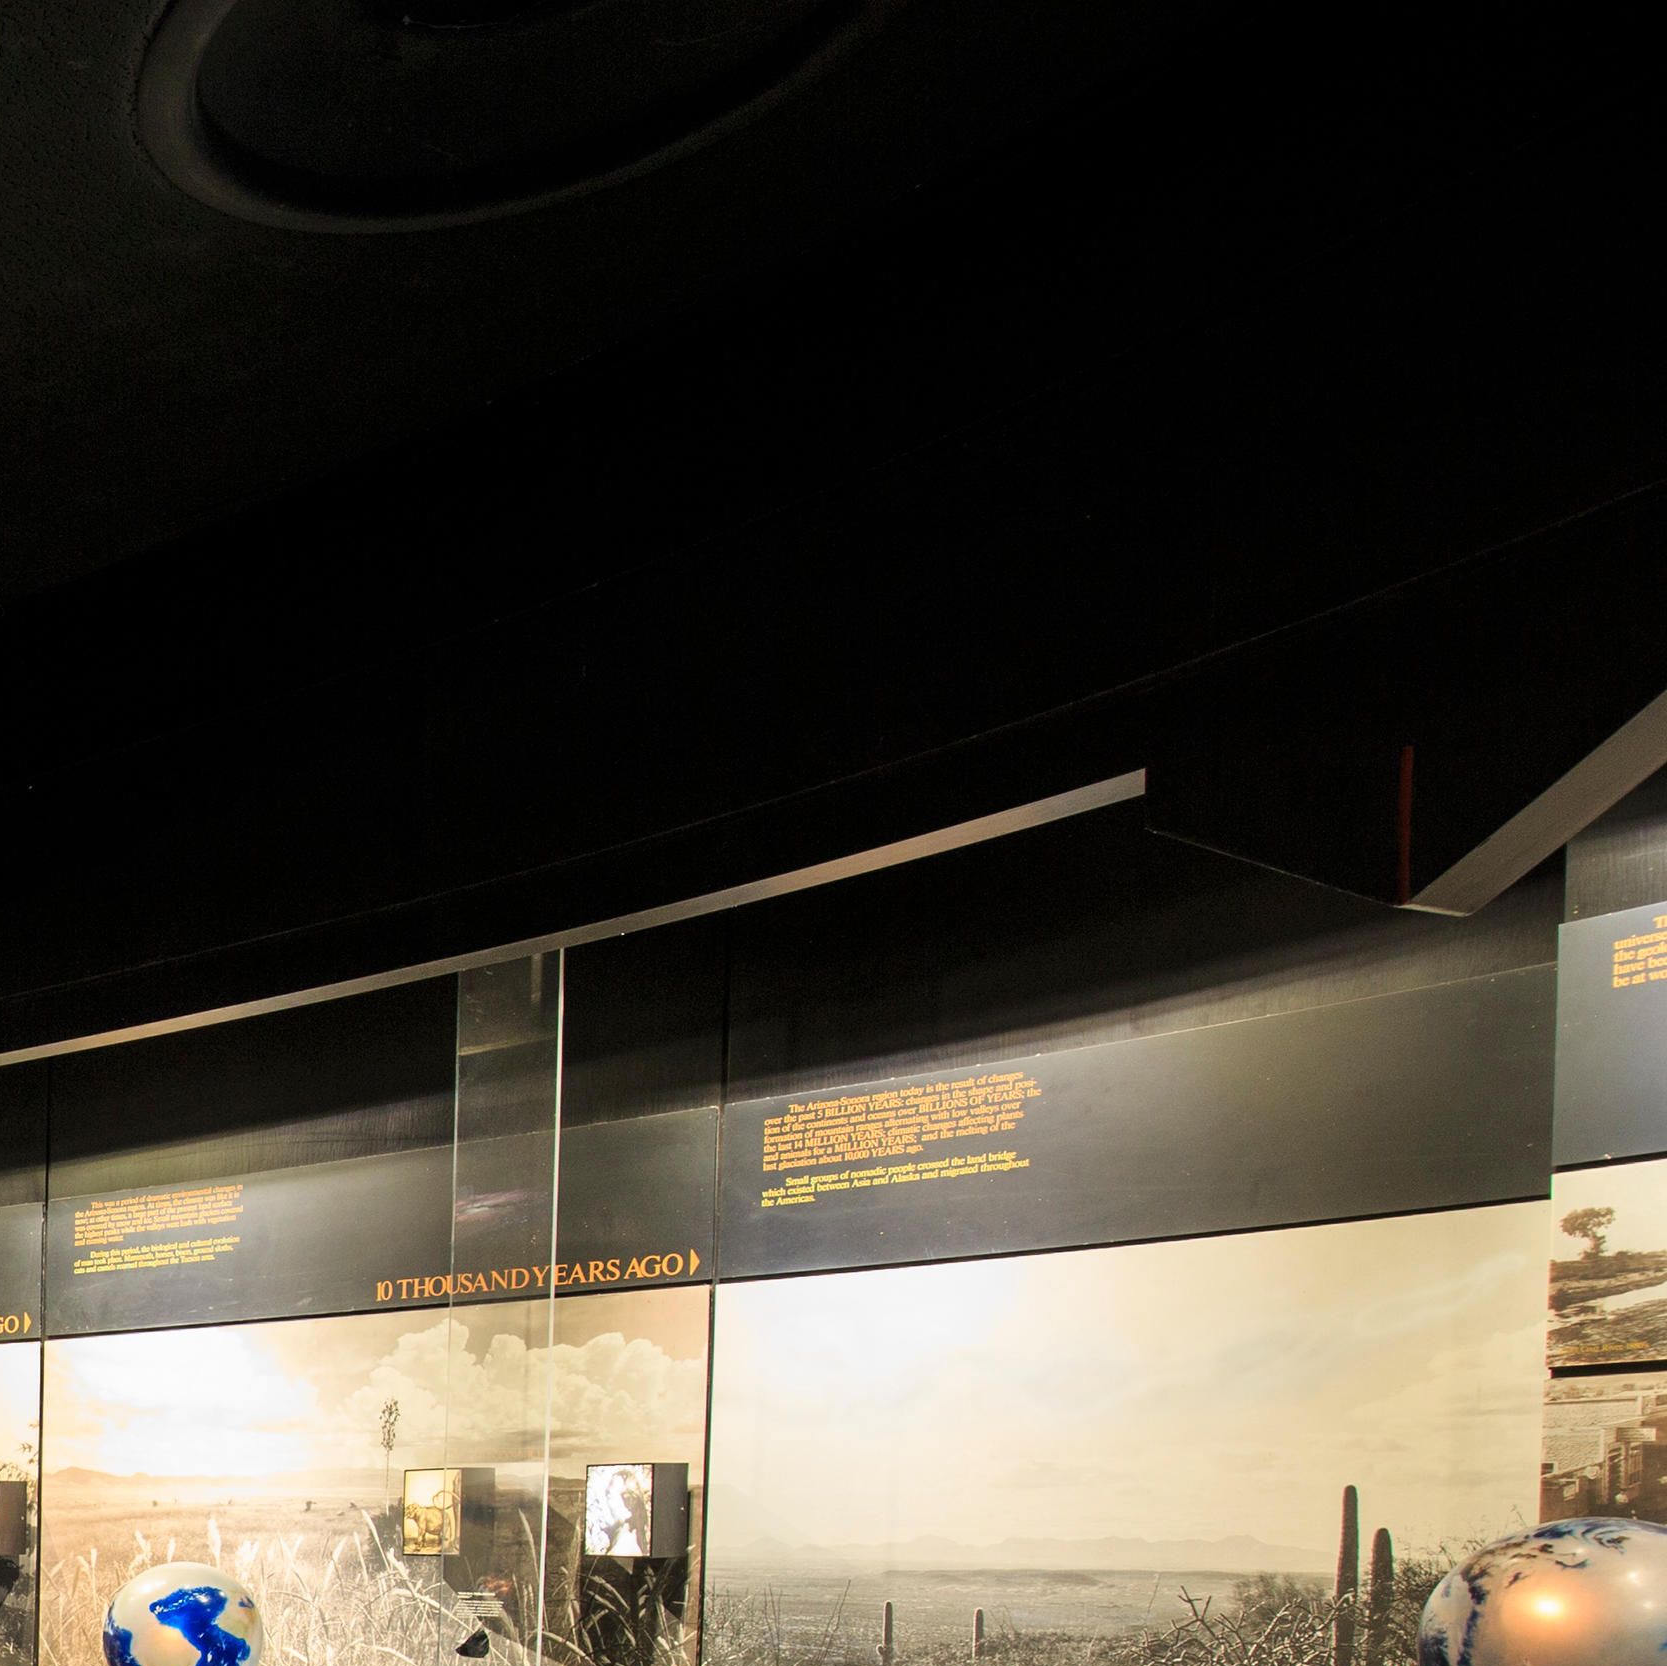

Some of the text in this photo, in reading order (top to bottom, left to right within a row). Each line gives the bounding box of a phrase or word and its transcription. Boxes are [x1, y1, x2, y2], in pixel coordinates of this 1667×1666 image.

[1613, 950, 1636, 962] the
[1613, 961, 1646, 975] have
[764, 1117, 782, 1126] over
[783, 1115, 796, 1123] the
[798, 1112, 815, 1123] past
[817, 1109, 822, 1118] 5
[824, 1103, 866, 1117] BILLION
[905, 1094, 939, 1106] changes
[941, 1091, 949, 1100] in
[952, 1089, 966, 1098] the
[968, 1086, 992, 1098] shape
[995, 1080, 1012, 1092] and
[764, 1127, 780, 1135] tion
[781, 1123, 790, 1132] of
[792, 1122, 804, 1131] the
[806, 1117, 848, 1129] continents
[850, 1114, 865, 1123] and
[867, 1111, 895, 1120] oceans
[897, 1108, 916, 1116] over
[918, 1097, 967, 1112] BILLIONS
[969, 1094, 985, 1105] OF
[1026, 1087, 1041, 1097] the
[788, 1104, 805, 1113] The
[872, 1091, 897, 1103] region
[900, 1087, 924, 1098] today
[926, 1084, 933, 1093] is
[935, 1082, 949, 1091] the
[951, 1077, 974, 1089] result
[976, 1075, 987, 1085] of
[988, 1072, 1023, 1084] changes
[763, 1102, 1021, 1144] formation of mountain ranges alternating with low valleys over
[763, 1144, 775, 1153] the
[794, 1139, 802, 1148] 14
[804, 1133, 848, 1147] MILLION
[921, 1119, 956, 1133] changes
[958, 1115, 994, 1128] affecting
[996, 1109, 1024, 1123] plants
[763, 1153, 778, 1162] and
[780, 1147, 811, 1160] animals
[813, 1146, 824, 1155] for
[834, 1138, 877, 1152] MILLION
[921, 1133, 938, 1141] and
[940, 1128, 953, 1138] the
[955, 1123, 987, 1136] melting
[989, 1122, 999, 1132] of
[1001, 1122, 1015, 1130] the
[762, 1163, 776, 1171] last
[778, 1156, 816, 1171] glaciation
[818, 1155, 842, 1164] about
[870, 1144, 904, 1156] YEARS
[785, 1152, 1016, 1186] Small groups of nomadic people crossed the land bridge
[761, 1159, 1029, 1198] which existed between Asia and Alaska and migrated throughout
[761, 1199, 774, 1207] the
[377, 1252, 684, 1301] 10 THOUSAND YEARS AGO
